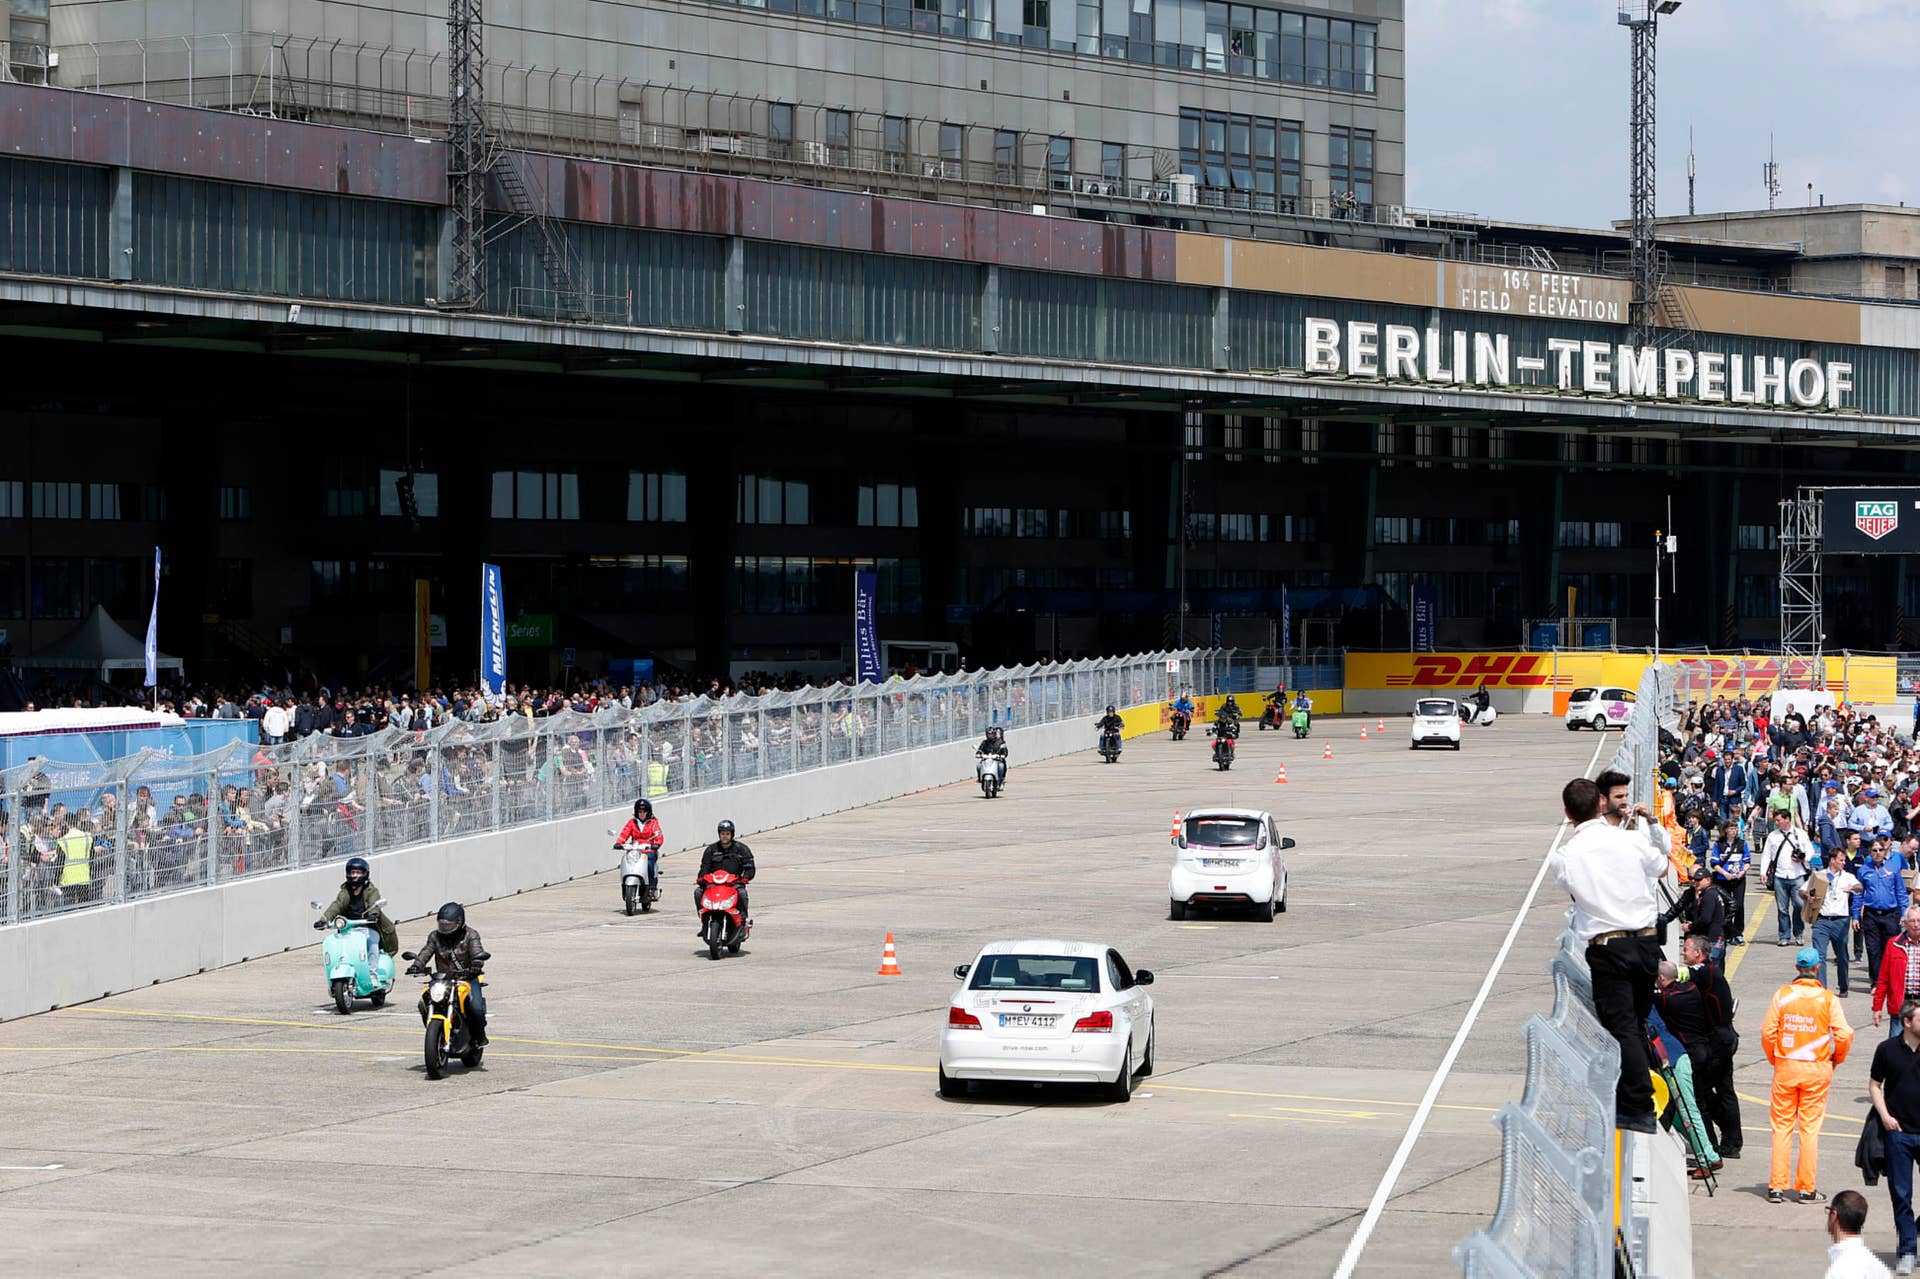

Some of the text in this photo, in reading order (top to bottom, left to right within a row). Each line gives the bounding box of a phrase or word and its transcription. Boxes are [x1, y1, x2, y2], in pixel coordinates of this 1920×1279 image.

[1503, 270, 1580, 295] 164 FEET
[1461, 288, 1618, 320] FIELD ELEVATION
[1859, 504, 1894, 515] TAG
[1858, 518, 1895, 536] HEUER
[489, 568, 504, 676] MICHELIN
[857, 588, 877, 676] Julius Bär
[1411, 655, 1548, 686] DHL
[1032, 1017, 1055, 1027] 4112
[1783, 1022, 1818, 1033] Marshal
